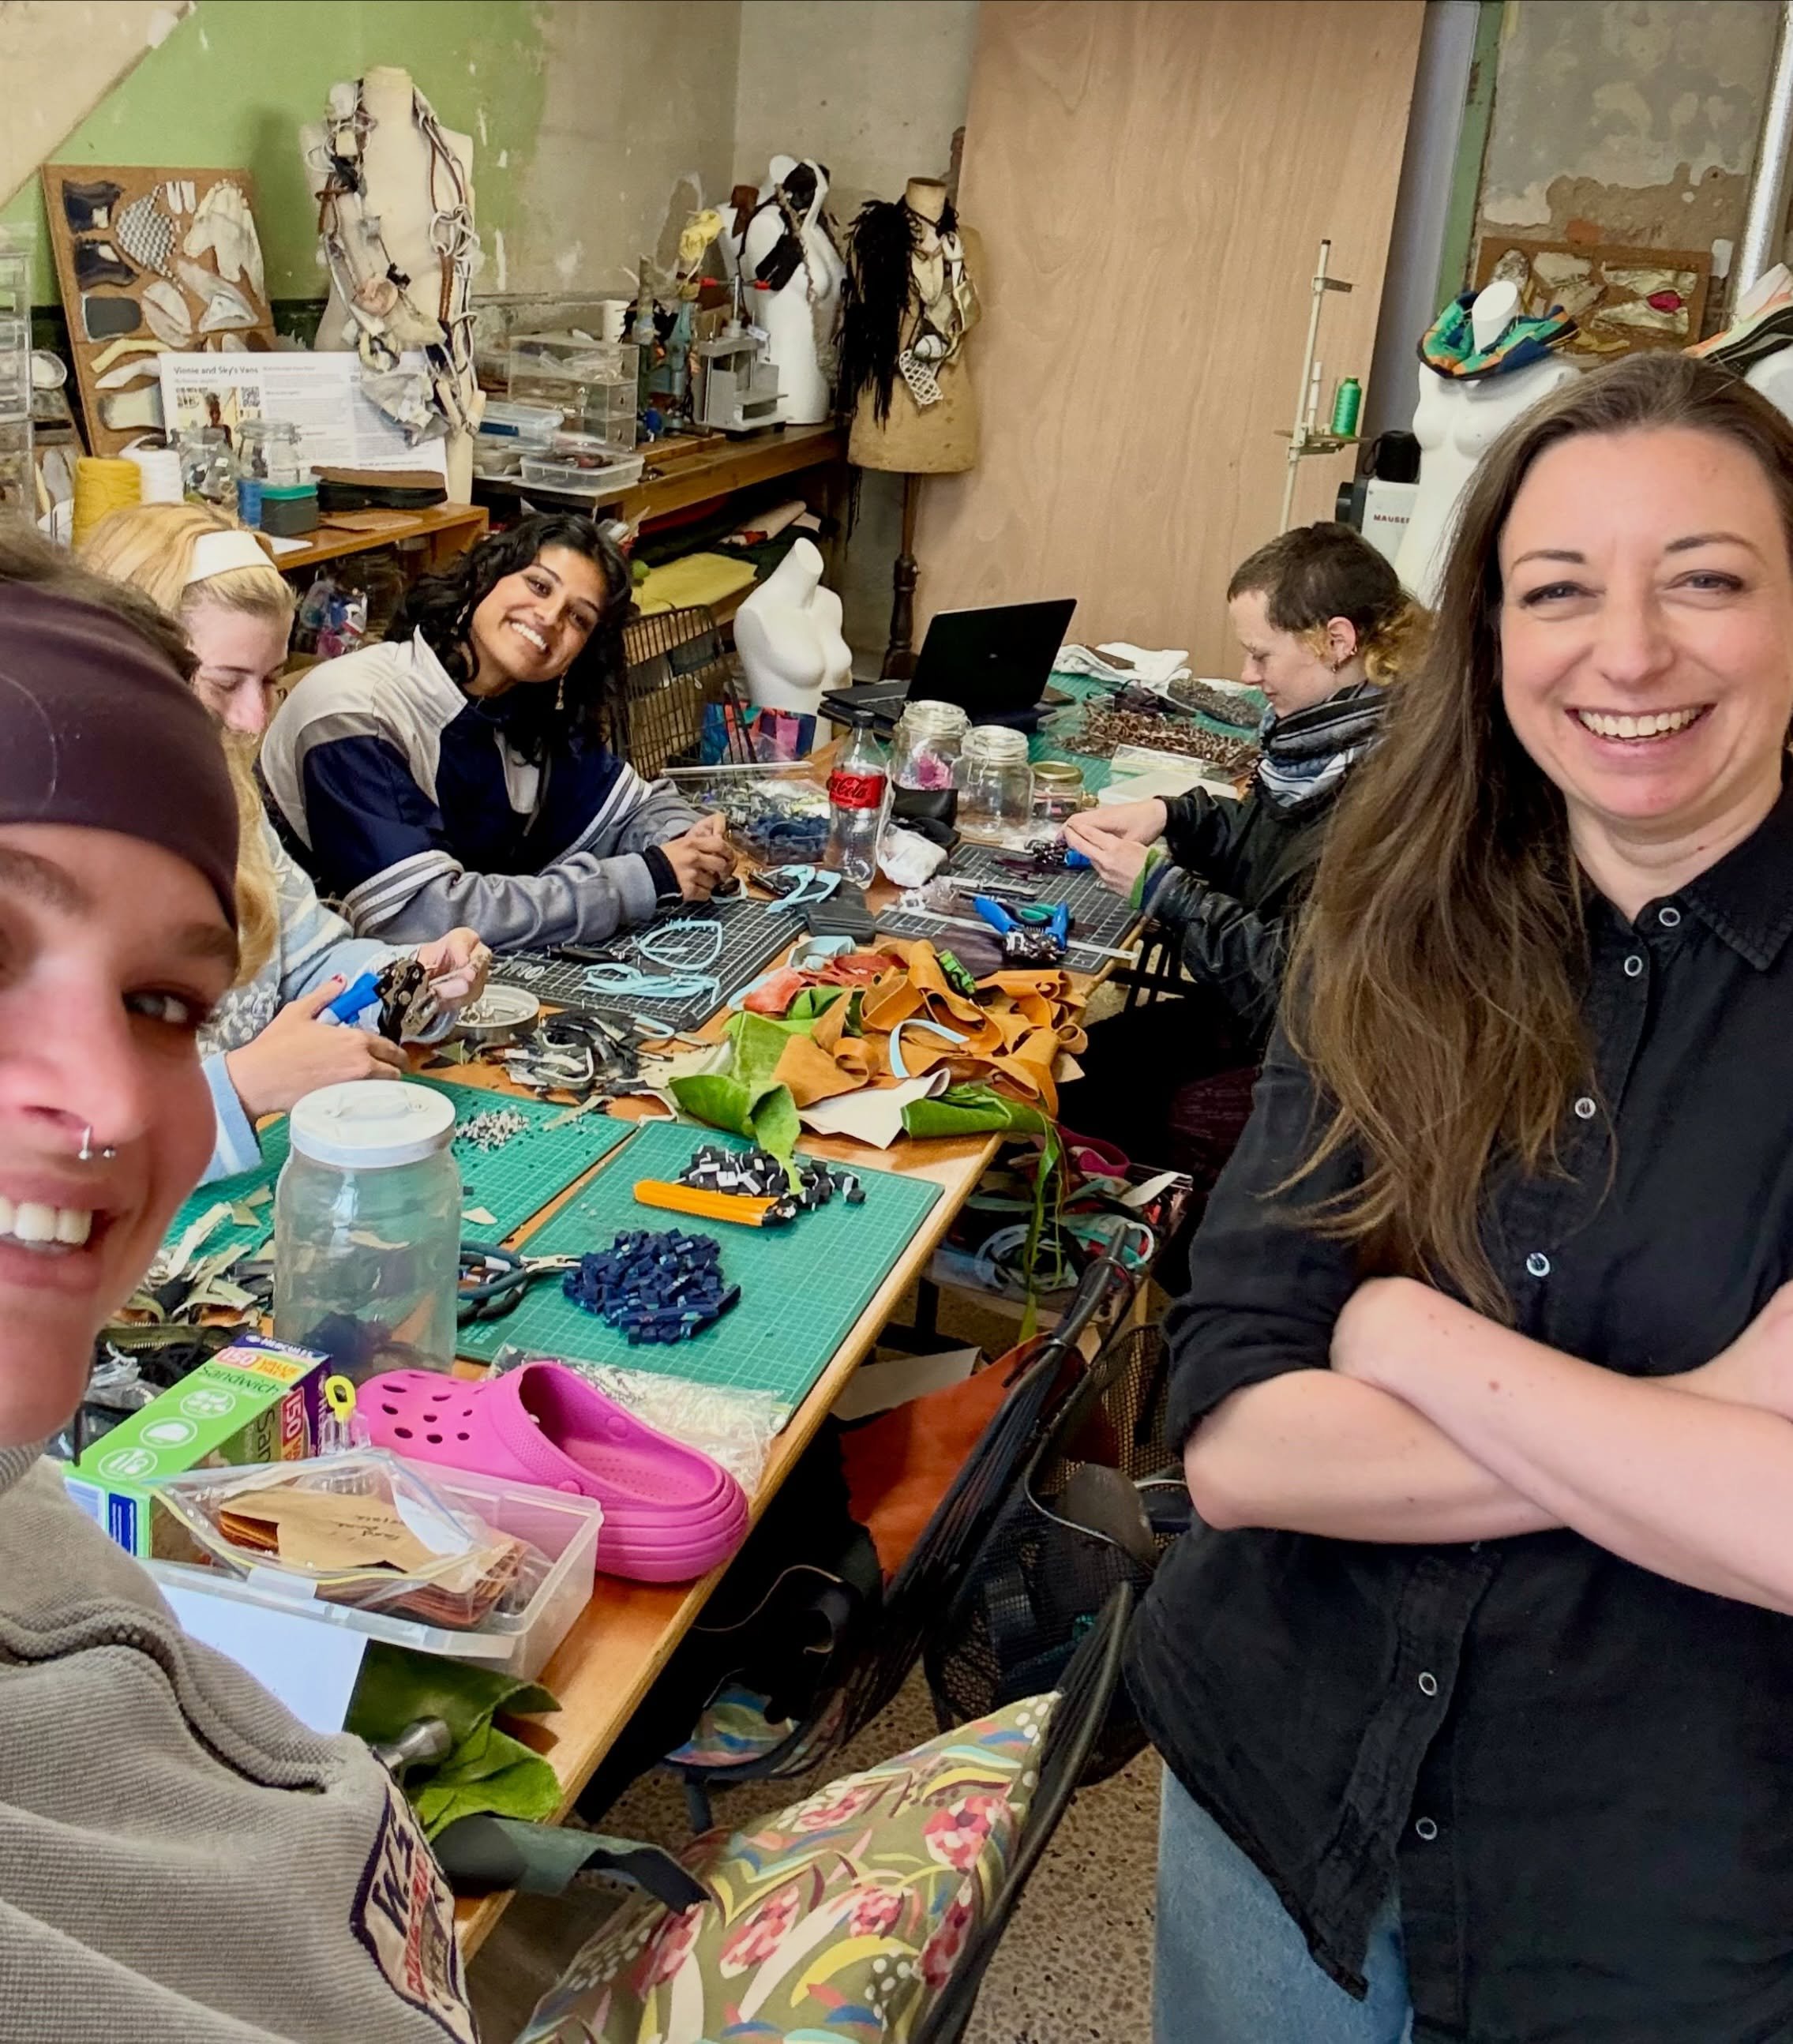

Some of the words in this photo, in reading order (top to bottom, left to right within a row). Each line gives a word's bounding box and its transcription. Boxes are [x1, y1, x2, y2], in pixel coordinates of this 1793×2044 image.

[201, 366, 216, 374] and
[220, 1348, 257, 1366] 150
[199, 1366, 279, 1395] Sandwich
[286, 1389, 302, 1439] 150
